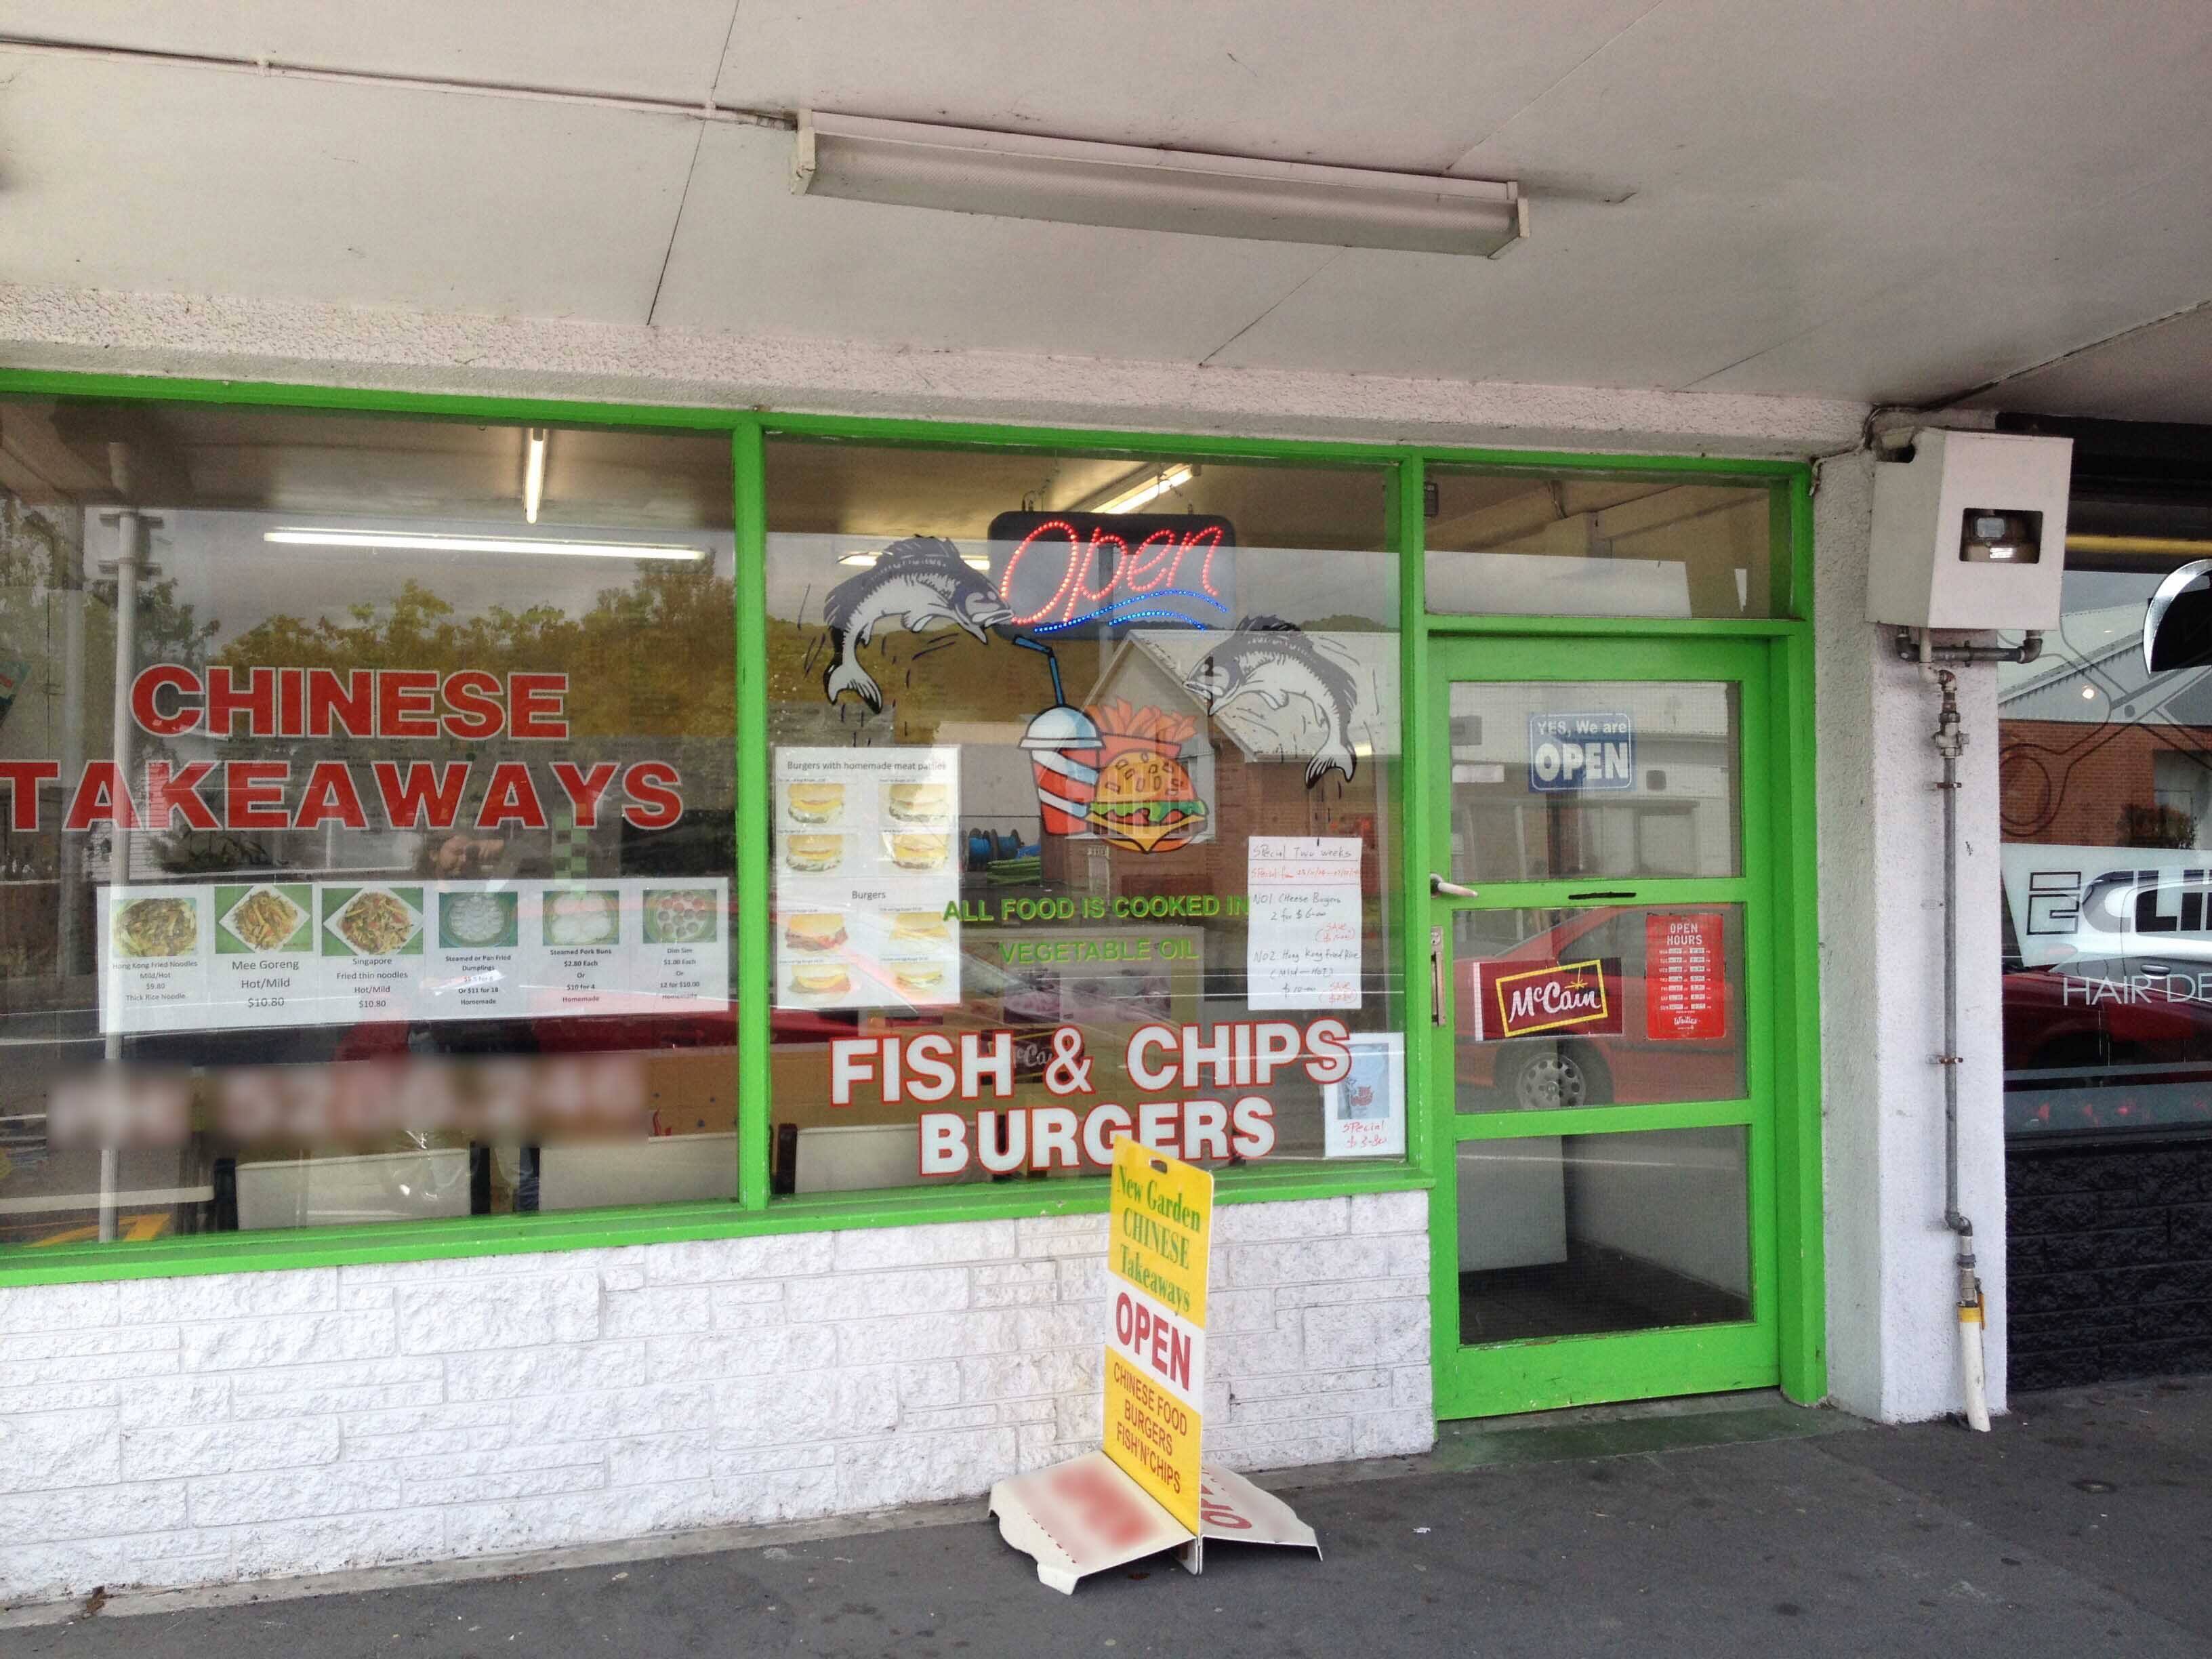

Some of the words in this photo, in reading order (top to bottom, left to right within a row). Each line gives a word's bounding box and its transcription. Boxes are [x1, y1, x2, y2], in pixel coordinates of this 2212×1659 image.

[1002, 520, 1224, 623] Open
[130, 663, 569, 740] CHINESE
[1537, 721, 1571, 737] YES,
[1576, 720, 1598, 734] We
[1603, 722, 1627, 734] are
[787, 761, 821, 771] Burgers
[822, 761, 841, 770] with
[844, 762, 892, 771] homemade
[1535, 743, 1629, 781] OPEN
[0, 759, 683, 830] TAKEAWAYS
[1294, 847, 1315, 859] Two
[1321, 846, 1351, 857] weeks
[852, 890, 885, 900] Burgers
[943, 899, 994, 921] ALL
[1001, 897, 1074, 920] FOOD
[1084, 896, 1105, 918] IS
[1112, 894, 1219, 918] COOKED
[1226, 893, 1250, 916] IN
[2026, 869, 2212, 935] ECLI
[1666, 935, 1702, 945] HOURS
[1670, 923, 1698, 933] OPEN
[232, 961, 256, 970] Mee
[260, 960, 300, 970] Goreng
[352, 958, 392, 966] Singapore
[998, 940, 1151, 965] VEGETABLE
[1160, 937, 1199, 960] OIL
[242, 977, 290, 989] Hot/Mild
[354, 985, 390, 994] Hot/Mild
[2063, 976, 2152, 1006] HAIR
[247, 997, 285, 1008] $10.80
[359, 1000, 386, 1008] $10.80
[1509, 981, 1601, 1023] McCain
[830, 1030, 1013, 1107] FISH
[1044, 1023, 1094, 1097] &
[1126, 1017, 1352, 1092] CHIPS
[919, 1094, 1276, 1176] BURGERS
[1117, 1164, 1142, 1202] New
[1147, 1179, 1201, 1232] Garden
[1123, 1207, 1190, 1270] CHINESE
[1120, 1244, 1190, 1316] Takeaways
[1116, 1292, 1191, 1391] OPEN
[1113, 1361, 1155, 1412] CHINESE
[1156, 1396, 1187, 1437] FOOD
[1124, 1399, 1173, 1457] BURGERS
[1117, 1420, 1181, 1495] FISH'N'CHIPS
